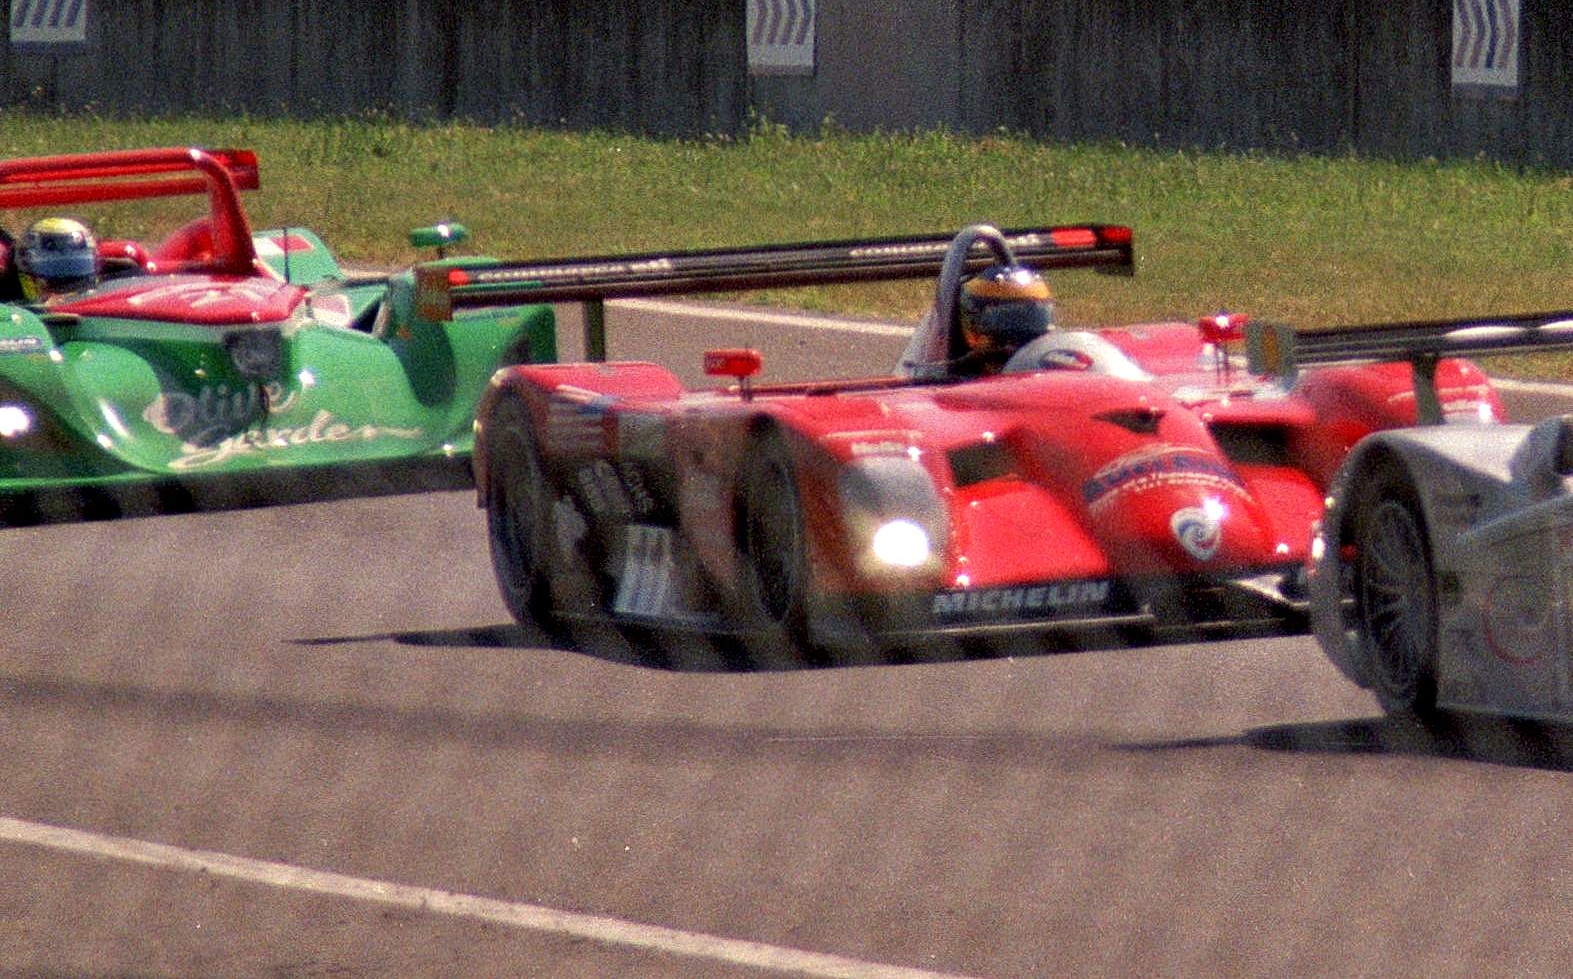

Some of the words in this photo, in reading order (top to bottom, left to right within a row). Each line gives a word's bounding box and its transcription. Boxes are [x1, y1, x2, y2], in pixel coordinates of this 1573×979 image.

[143, 381, 299, 434] Olive
[167, 407, 423, 470] Garden
[932, 580, 1111, 614] MICHELIN
